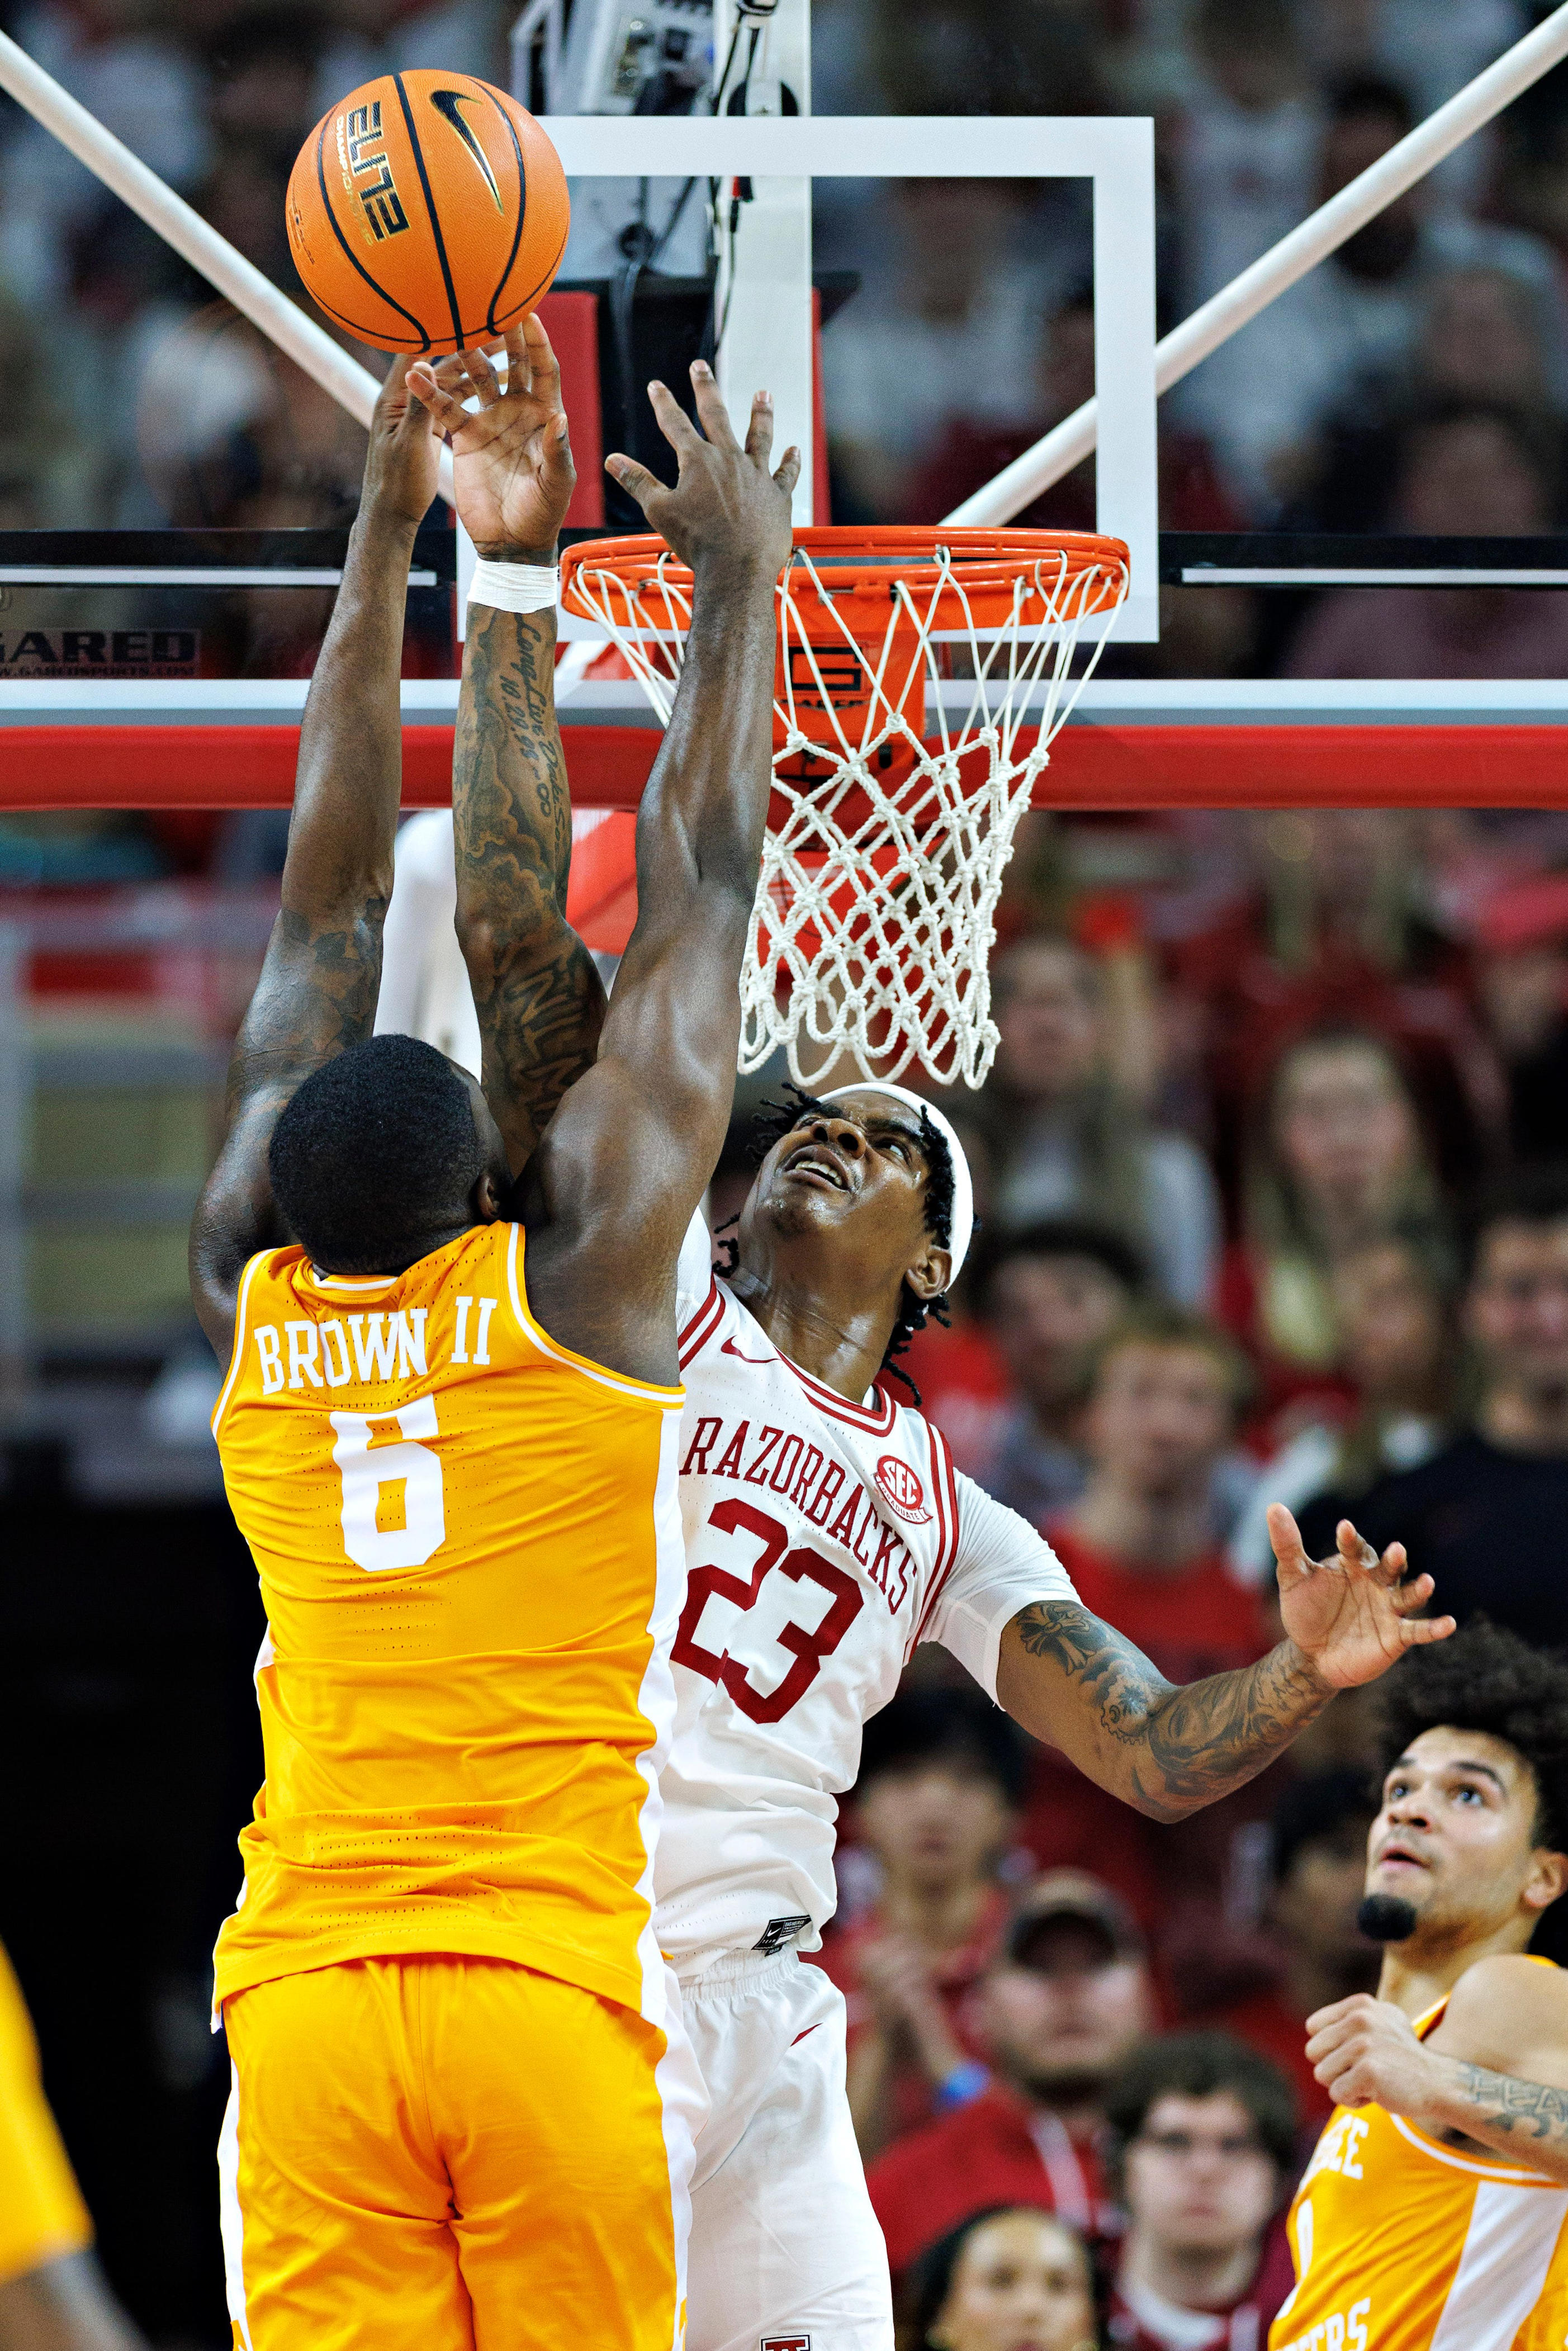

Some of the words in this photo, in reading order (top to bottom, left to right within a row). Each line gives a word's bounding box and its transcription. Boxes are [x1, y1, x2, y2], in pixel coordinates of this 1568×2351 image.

[347, 100, 411, 242] ELITE
[0, 632, 195, 663] ARED
[254, 1308, 429, 1395] BROWN
[450, 1296, 498, 1365] II
[330, 1392, 446, 1572] 6
[679, 1417, 917, 1615] RAZORBACKS
[882, 1487, 920, 1520] GRADUATE
[883, 1461, 918, 1505] SEC
[670, 1498, 864, 1724] 23
